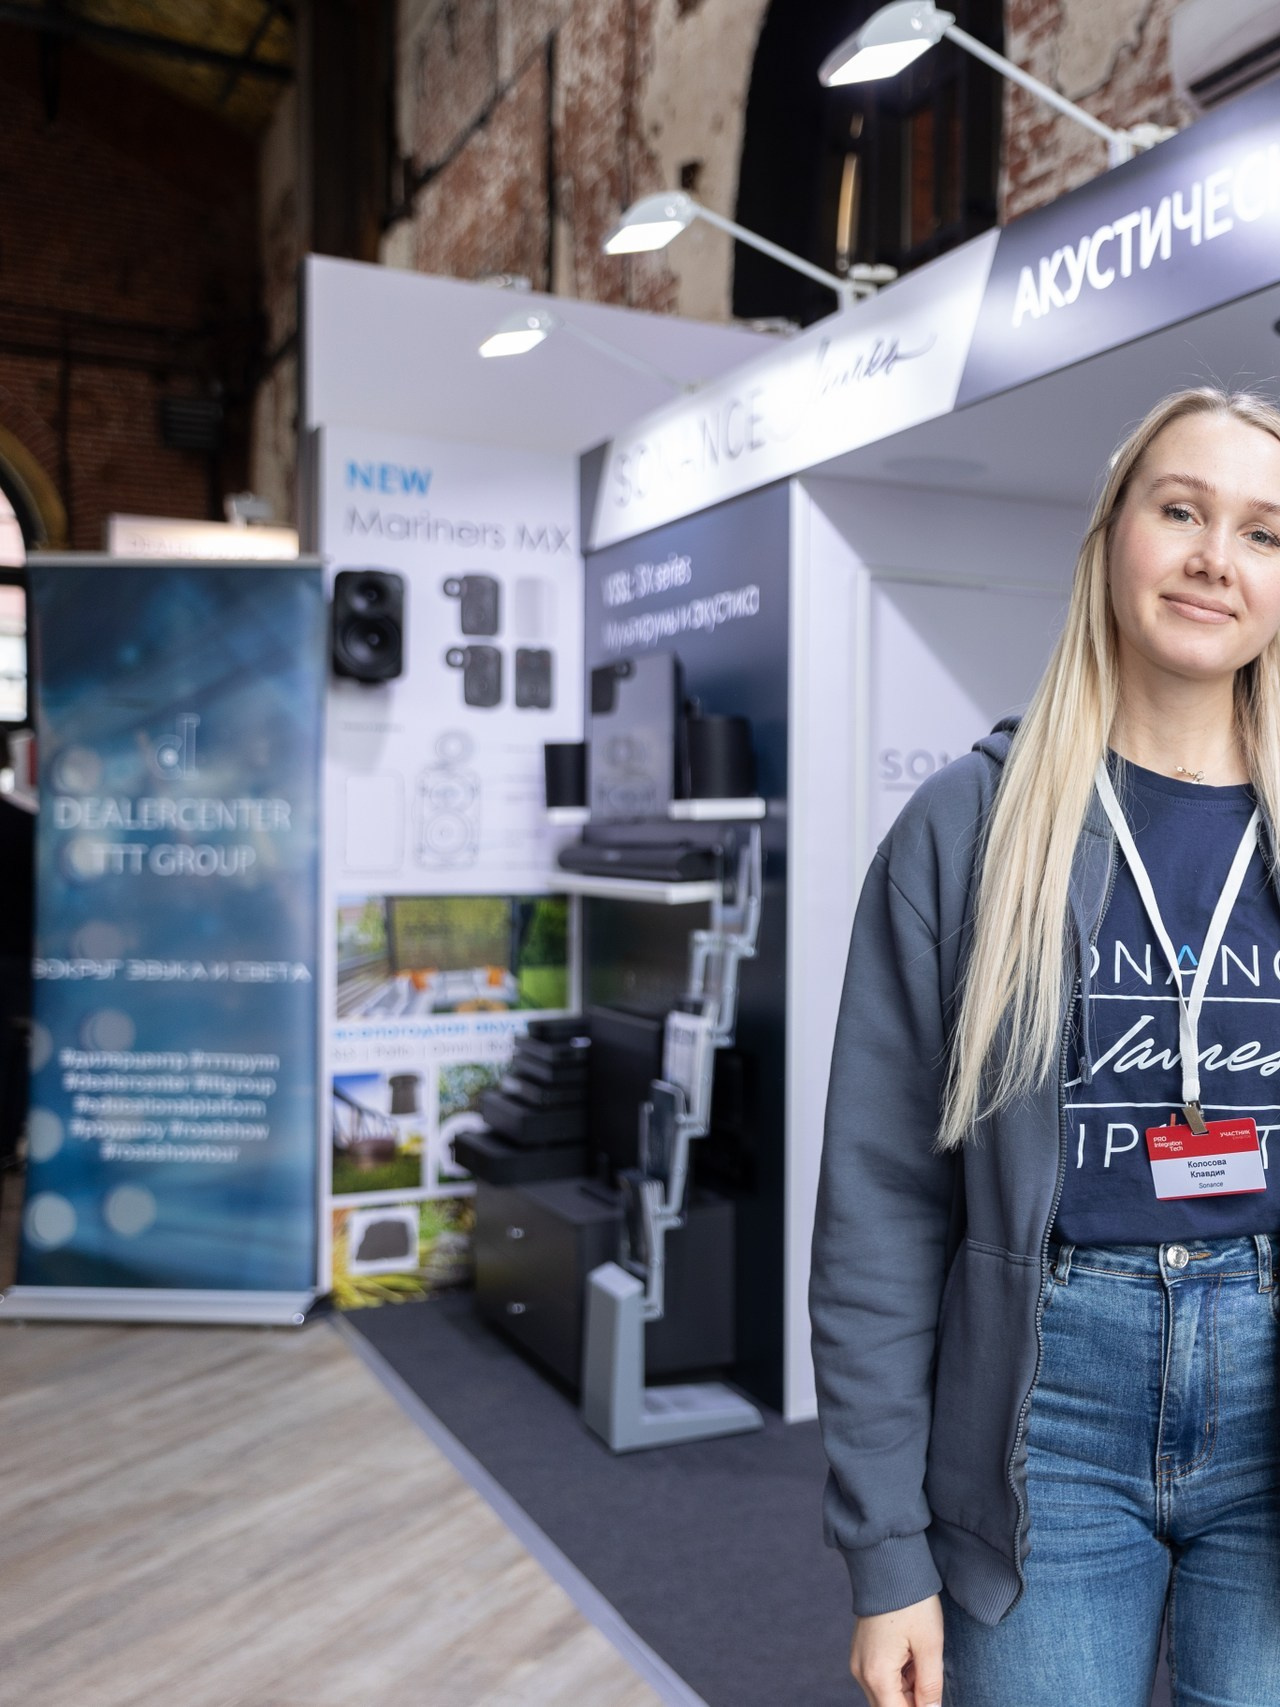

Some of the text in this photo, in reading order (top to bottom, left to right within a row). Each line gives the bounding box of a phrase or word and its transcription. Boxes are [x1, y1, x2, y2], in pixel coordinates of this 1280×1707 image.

[613, 386, 767, 507] SONCE
[346, 458, 433, 496] NEW
[343, 503, 572, 556] Mariners MX
[53, 796, 292, 831] DEALERCENTER
[148, 843, 257, 877] GROUP
[1076, 1122, 1280, 1170] IPT
[1154, 1140, 1183, 1149] Integration
[1220, 1129, 1251, 1138] УЧАСТНИК
[1187, 1159, 1227, 1169] Колосова
[1190, 1169, 1226, 1179] Клавдия
[1198, 1181, 1224, 1189] Sonance
